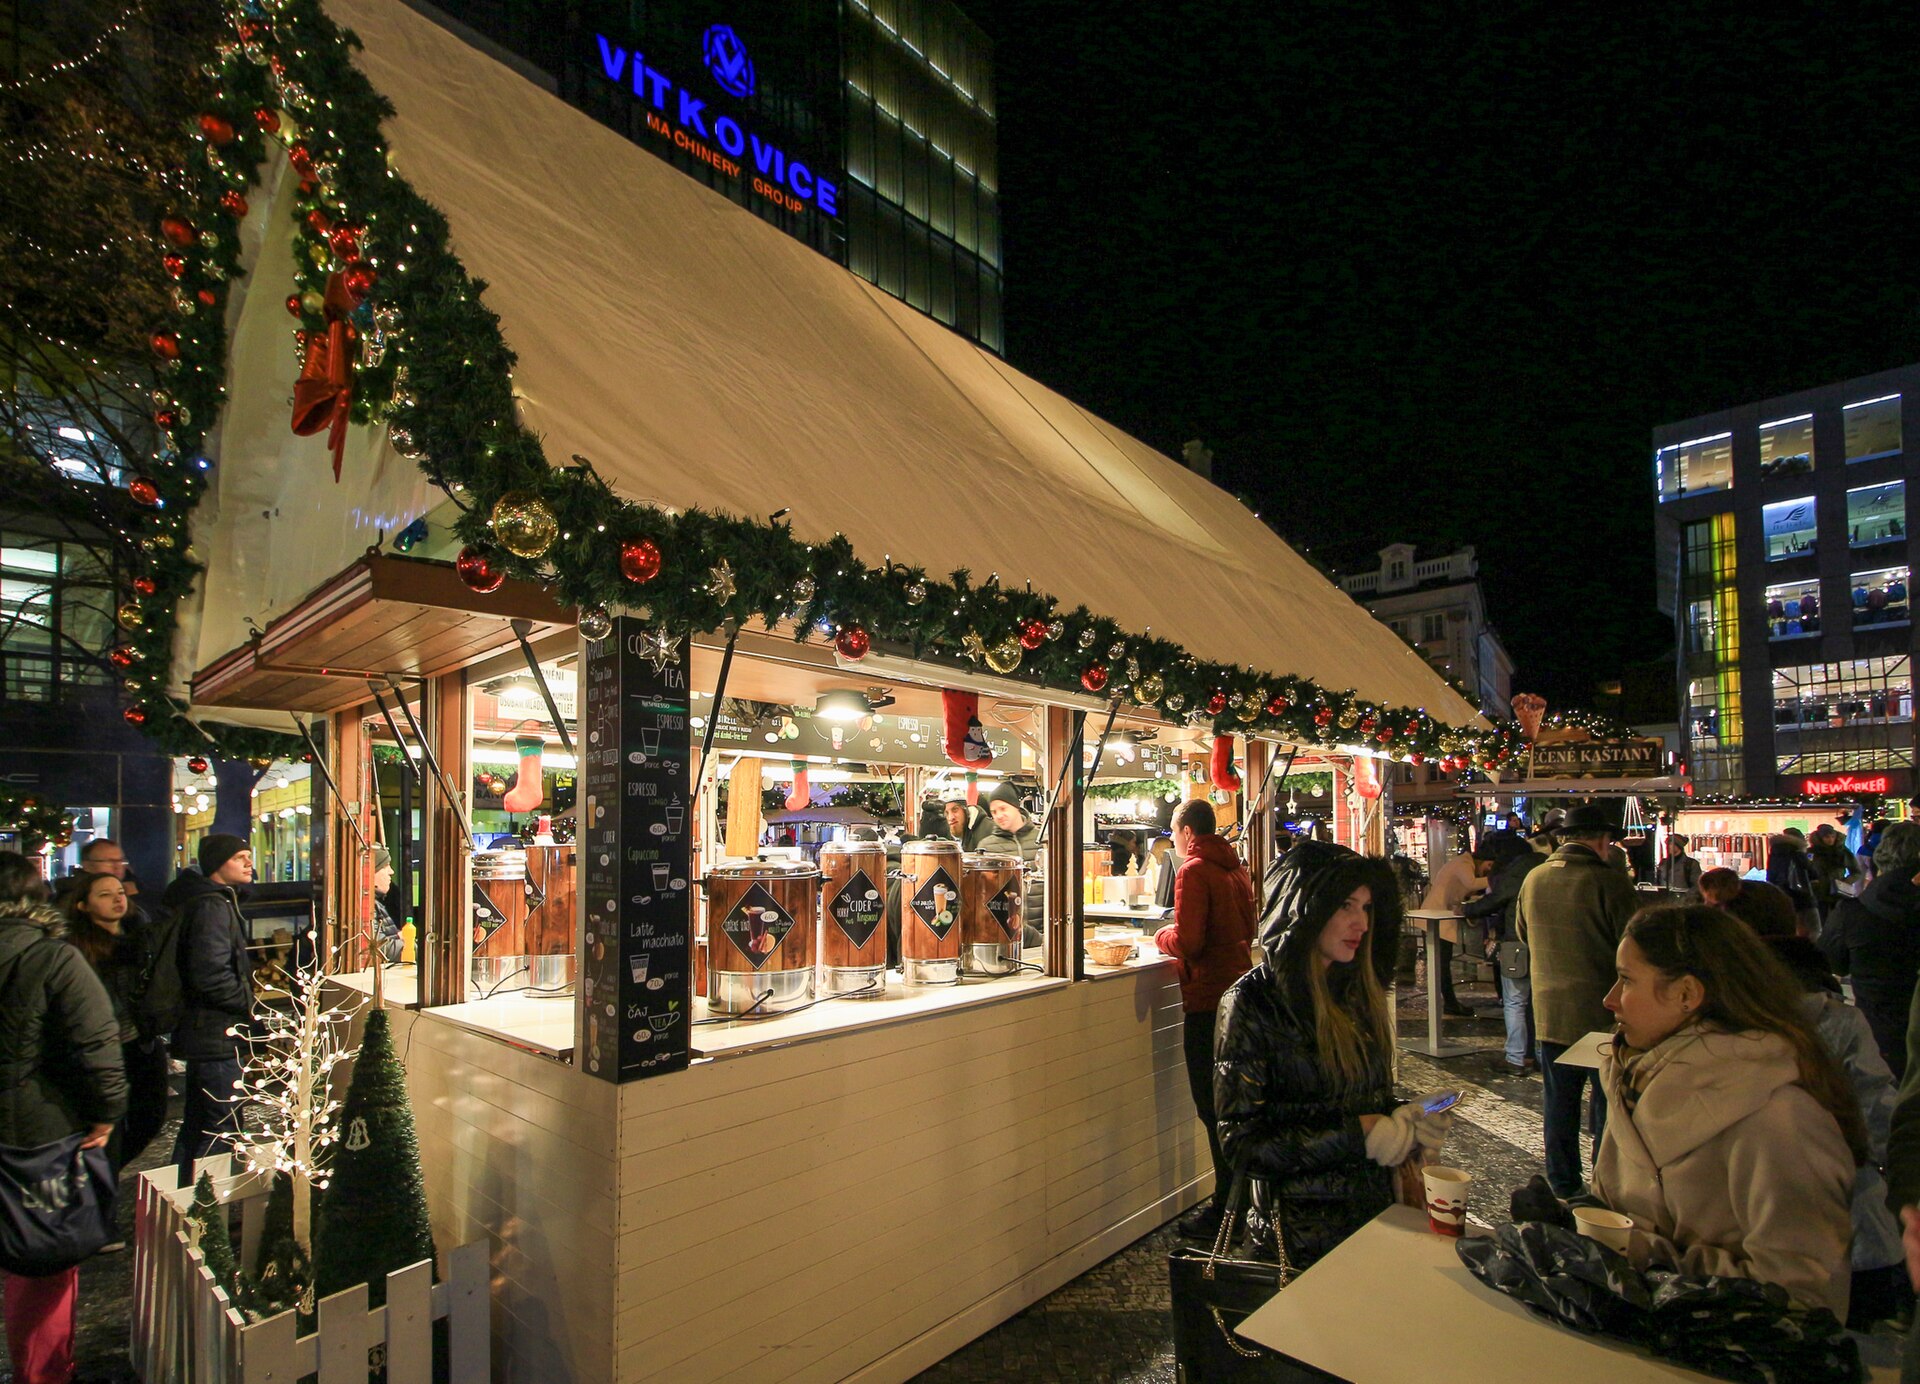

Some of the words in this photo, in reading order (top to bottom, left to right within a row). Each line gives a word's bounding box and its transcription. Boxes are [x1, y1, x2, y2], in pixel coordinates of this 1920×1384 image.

[647, 112, 741, 177] MACHINERY
[753, 178, 803, 213] GROUP
[664, 667, 685, 689] TEA
[657, 713, 684, 730] ESPRESSO
[1580, 745, 1653, 762] KAŠTANY
[628, 782, 657, 796] ESPRESSO
[850, 900, 872, 912] CIDER
[630, 922, 654, 938] Latte
[642, 933, 684, 949] macchiato
[628, 1003, 649, 1019] ČAJ
[654, 1017, 667, 1028] TEA
